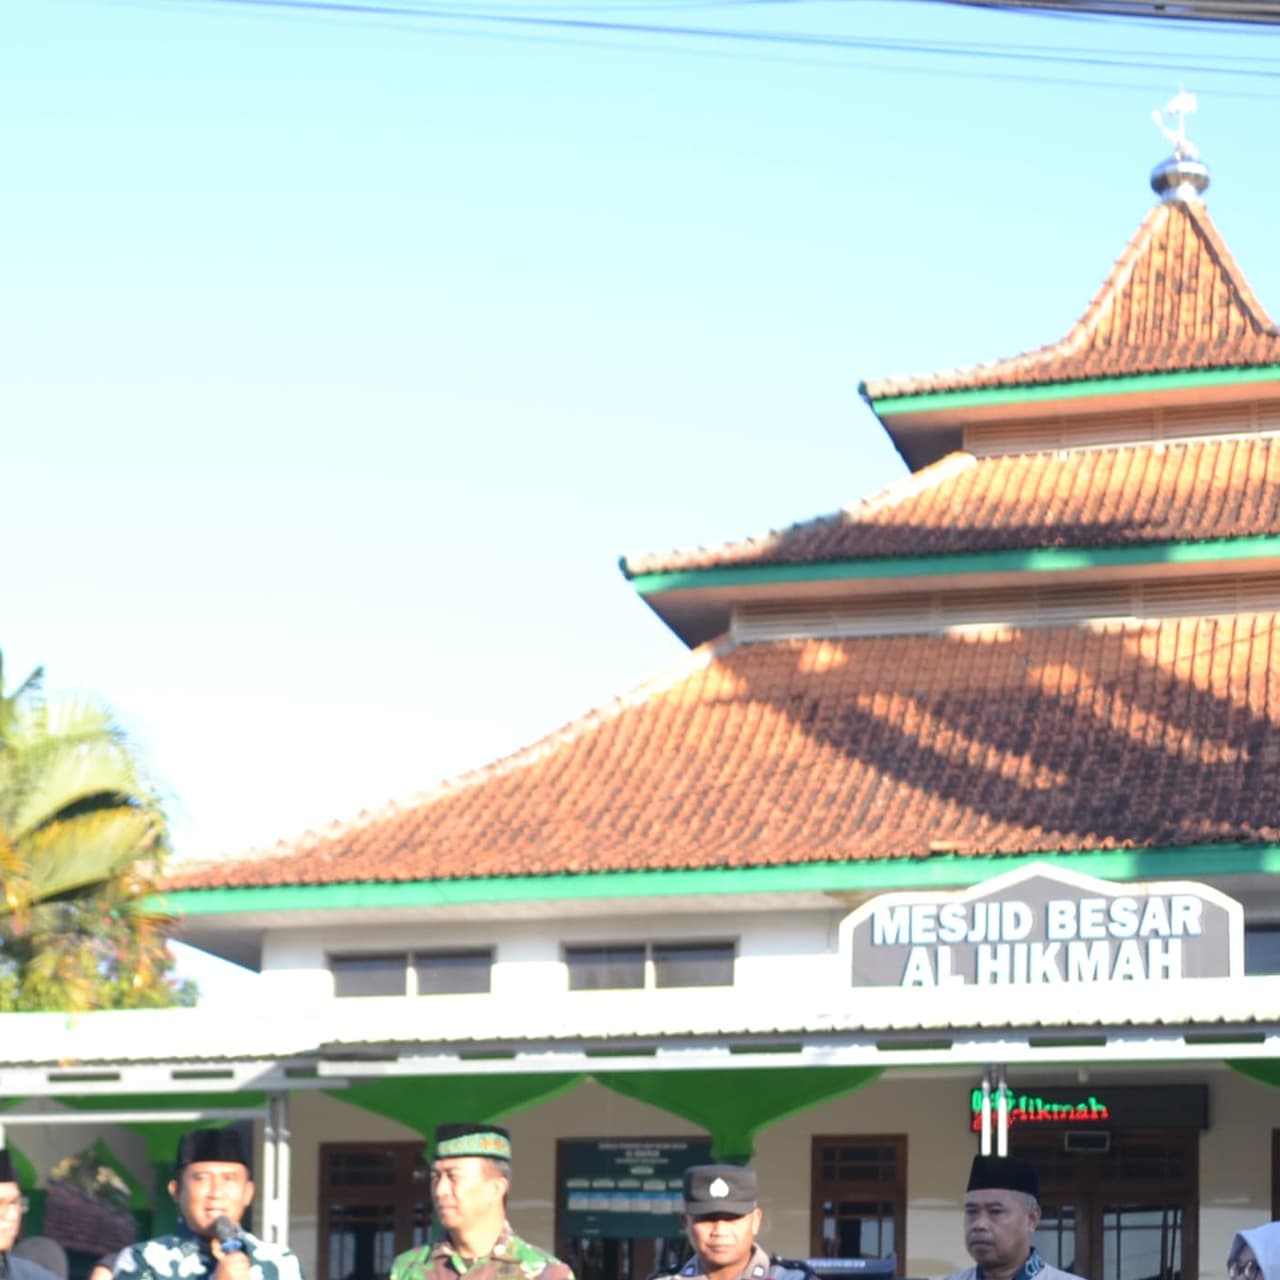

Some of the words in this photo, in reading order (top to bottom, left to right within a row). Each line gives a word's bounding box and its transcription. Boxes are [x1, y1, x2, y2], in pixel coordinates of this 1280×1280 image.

[871, 901, 1033, 946] MESJID
[1045, 895, 1203, 941] BESAR
[901, 944, 966, 987] AL
[975, 938, 1183, 986] HIKMAH
